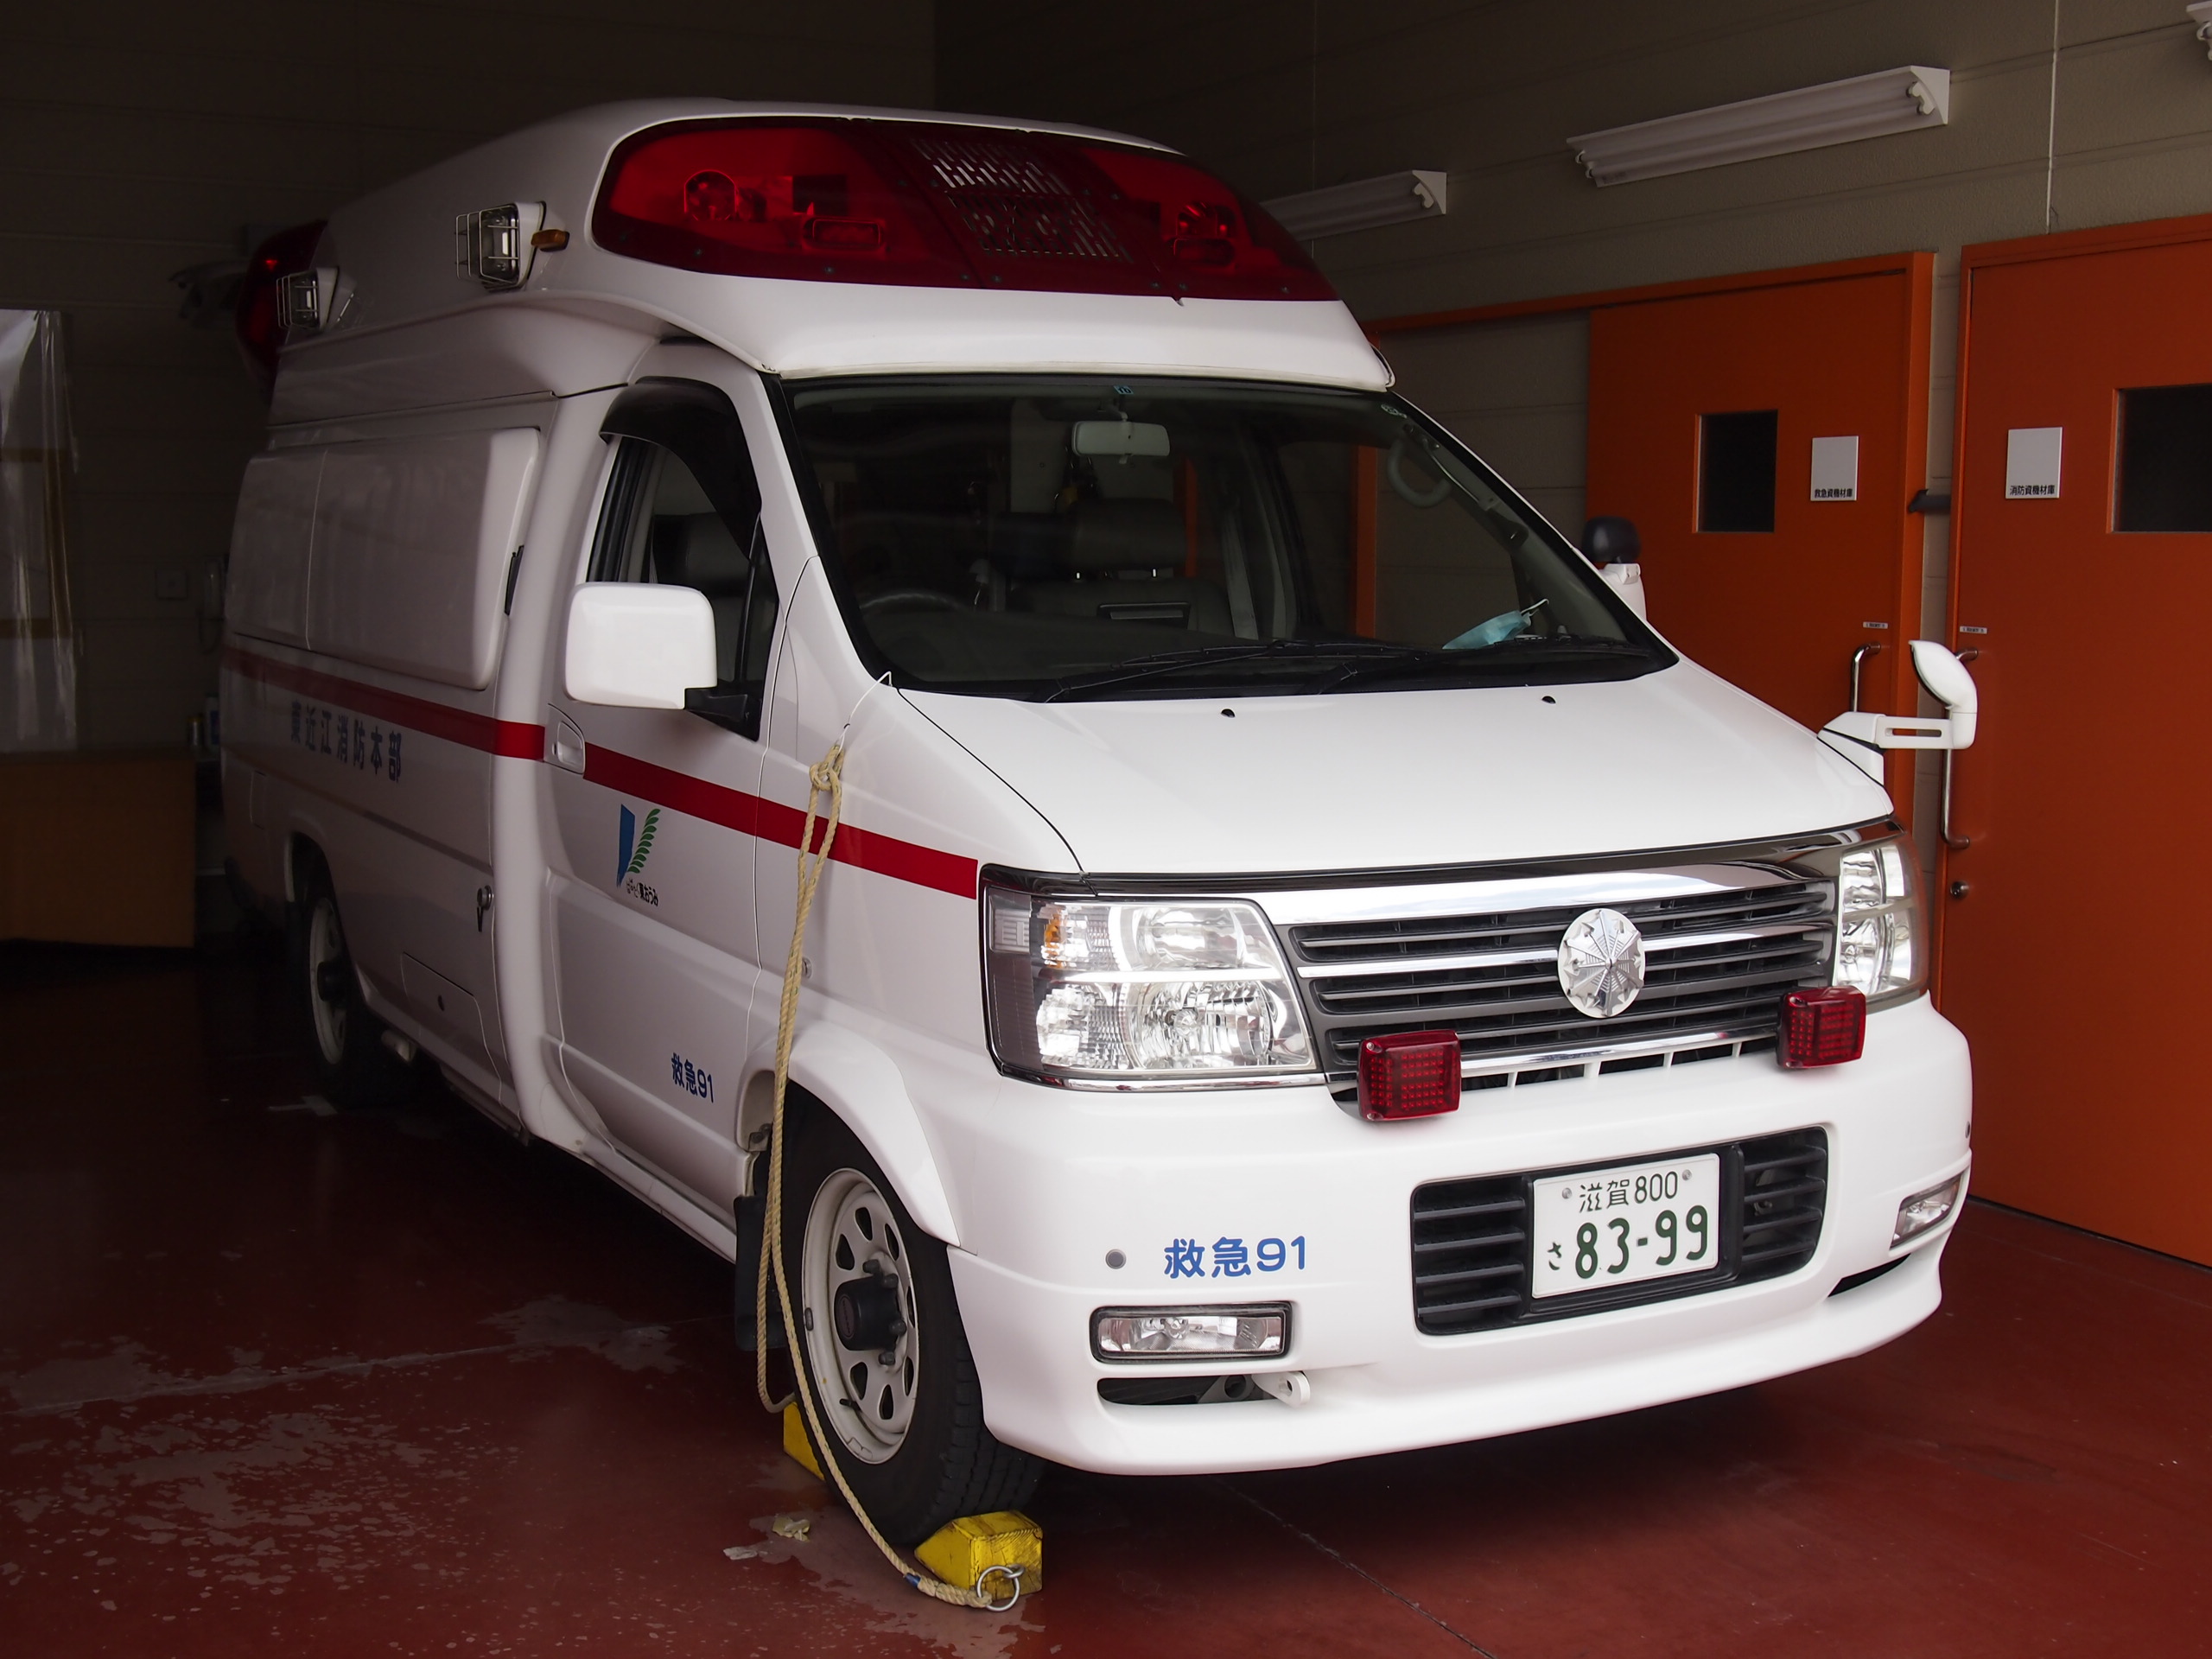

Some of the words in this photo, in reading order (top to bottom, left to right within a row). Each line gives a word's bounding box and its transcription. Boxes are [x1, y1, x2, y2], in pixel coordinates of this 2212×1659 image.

[1814, 487, 1853, 499] 救急資機材庫
[2009, 485, 2056, 496] 消防資機材庫
[290, 700, 402, 783] 東近江消防本部
[671, 1052, 714, 1103] 救急91
[1163, 1235, 1306, 1280] 救急91
[1574, 1205, 1708, 1279] 83-99
